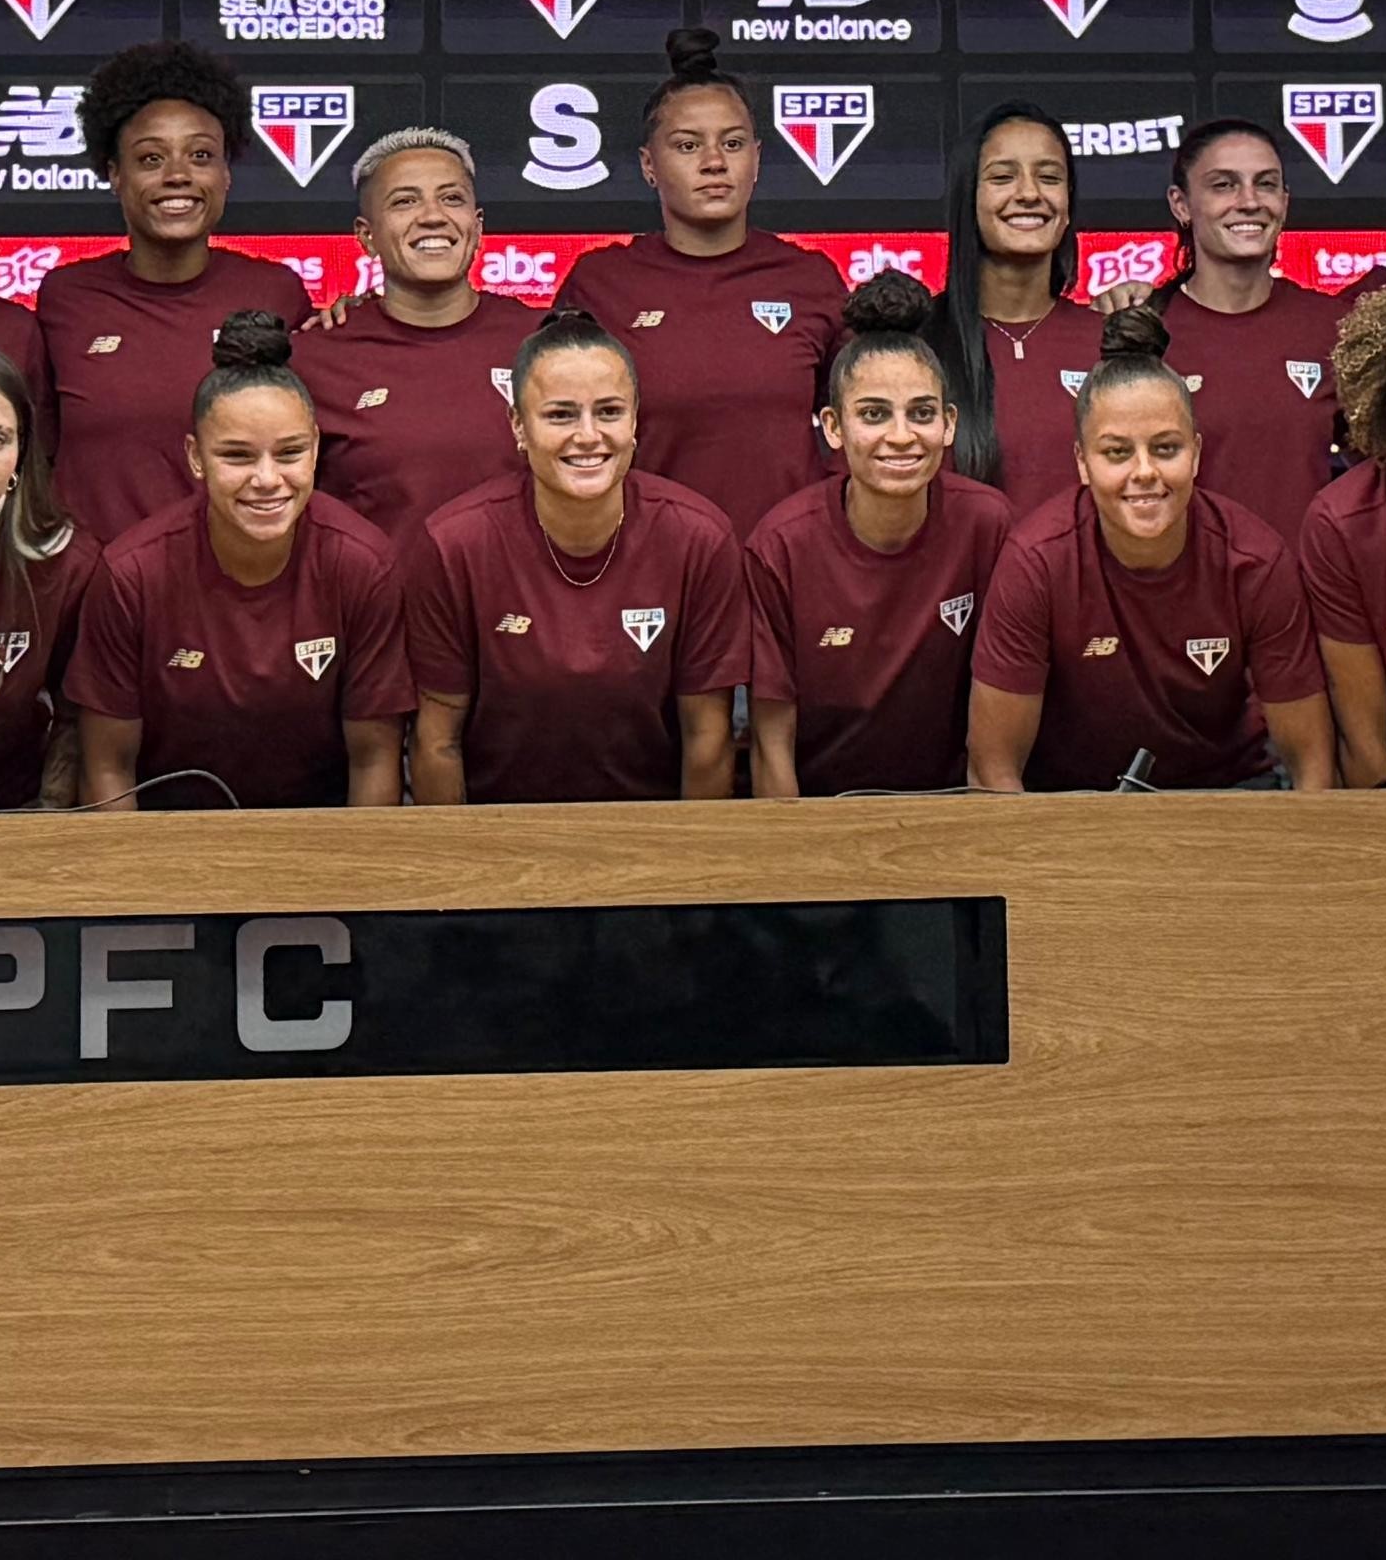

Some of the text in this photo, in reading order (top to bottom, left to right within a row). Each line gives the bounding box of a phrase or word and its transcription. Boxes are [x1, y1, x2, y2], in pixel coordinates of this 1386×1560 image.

[220, 16, 385, 40] TORCEDOR!
[732, 15, 911, 40] new balance
[262, 97, 343, 117] SPFC
[783, 95, 865, 115] SPFC
[1293, 93, 1371, 114] SPFC
[1062, 114, 1184, 156] ERBET
[13, 163, 110, 190] balan
[479, 245, 556, 283] abc
